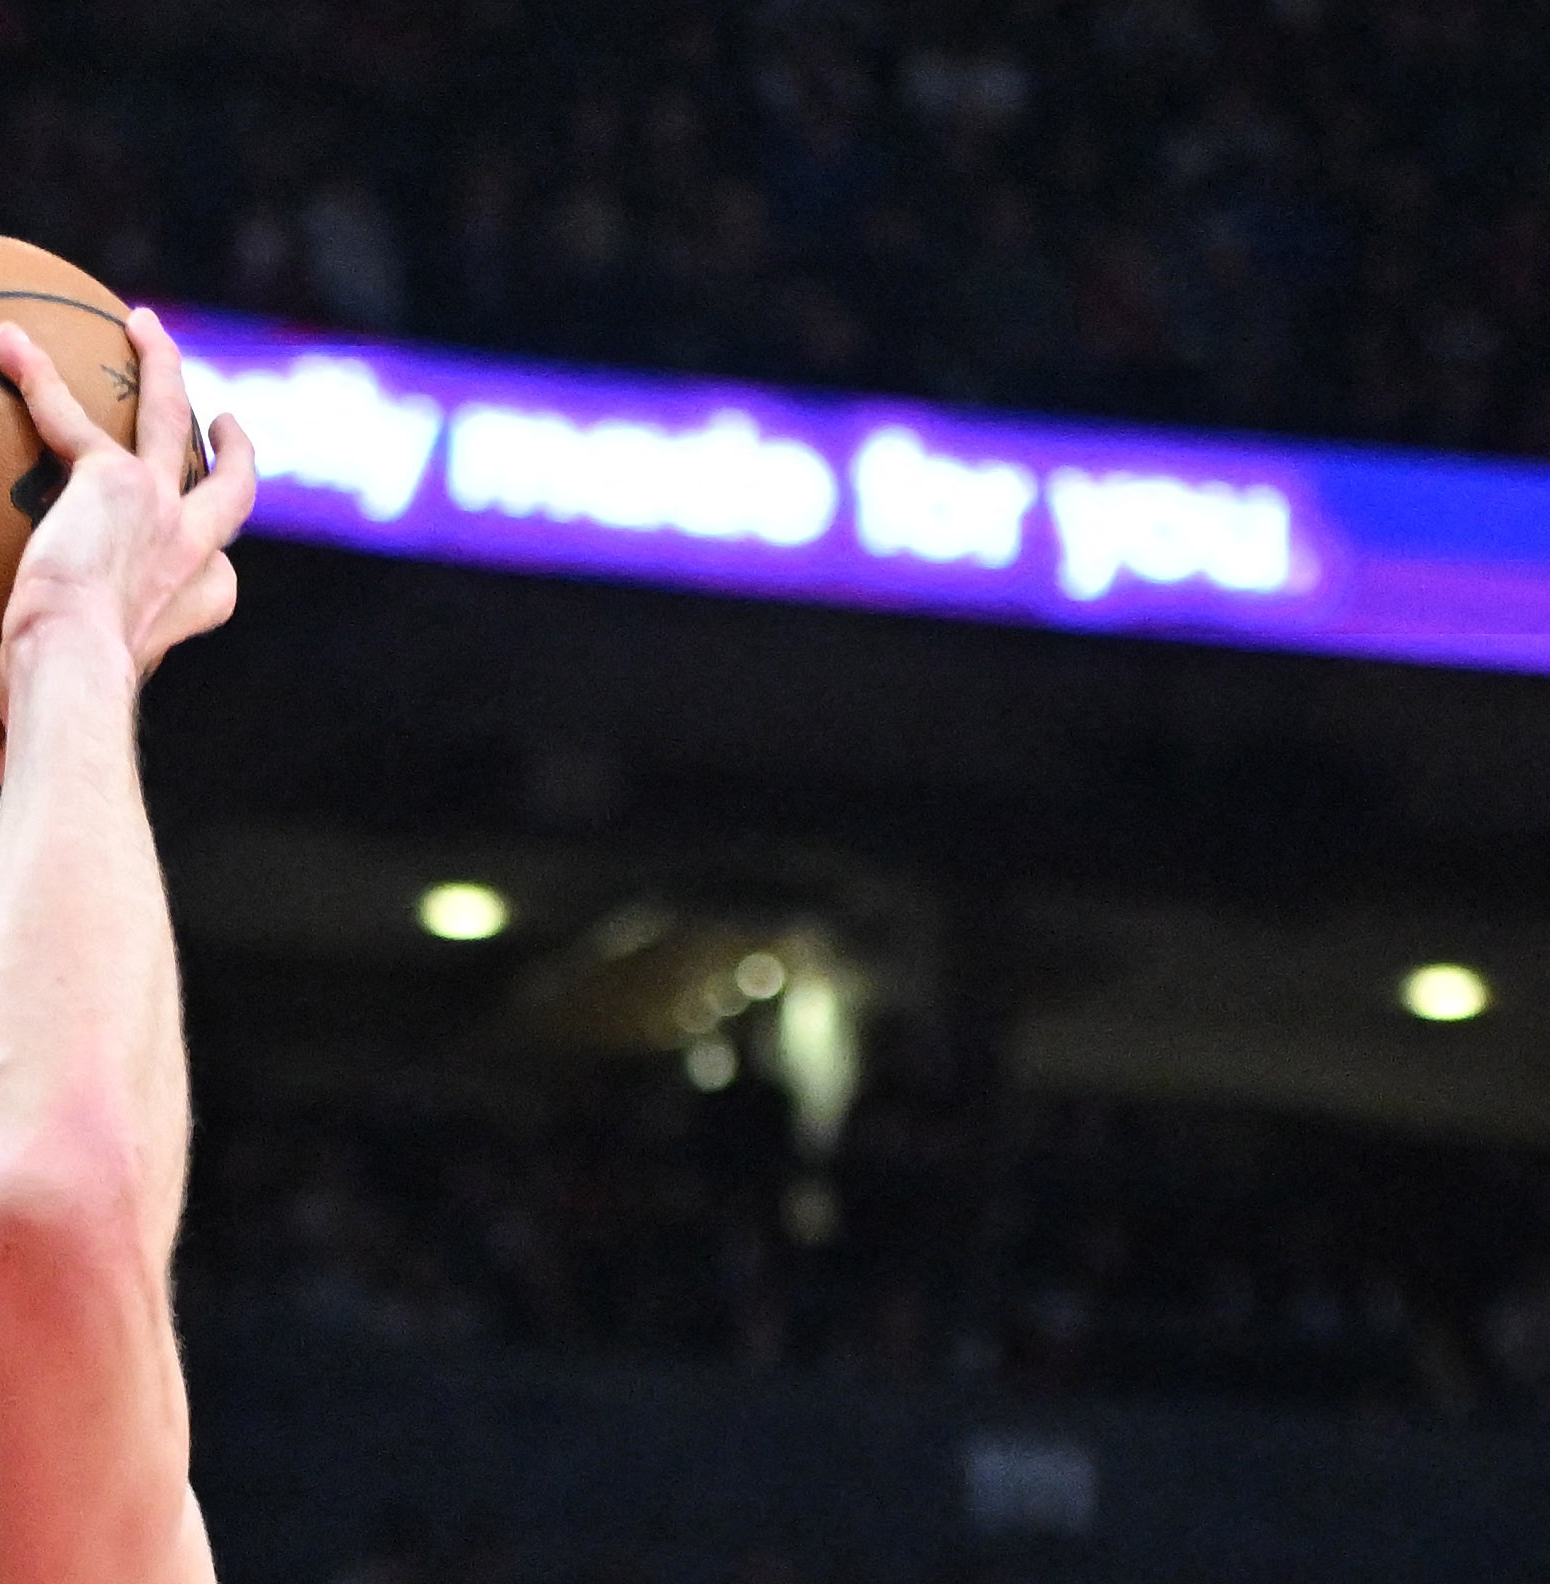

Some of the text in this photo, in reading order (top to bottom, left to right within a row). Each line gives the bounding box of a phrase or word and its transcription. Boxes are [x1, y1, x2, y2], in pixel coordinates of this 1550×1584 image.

[449, 406, 837, 546] made
[853, 430, 1035, 566] for
[1049, 473, 1291, 600] you
